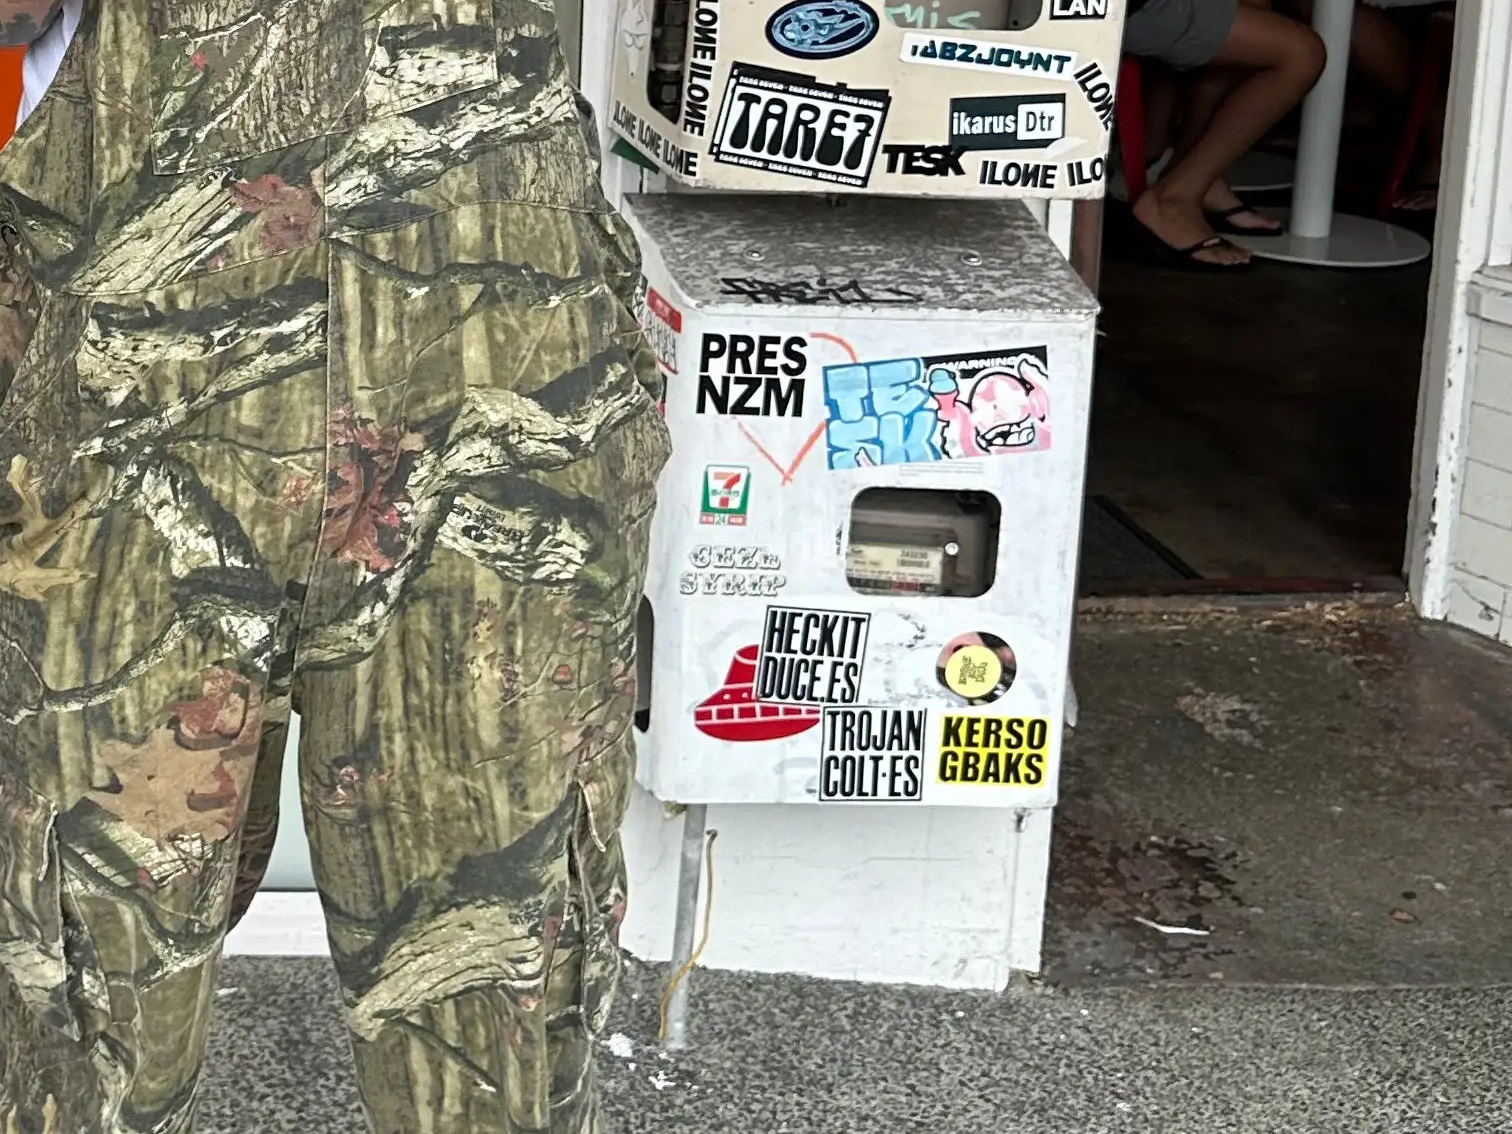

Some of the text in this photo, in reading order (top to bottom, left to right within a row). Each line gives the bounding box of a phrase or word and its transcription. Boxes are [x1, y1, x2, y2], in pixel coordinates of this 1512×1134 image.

[952, 111, 1055, 135] ikarus Dtr
[700, 333, 808, 376] PRES
[696, 375, 805, 417] NZM
[764, 610, 867, 659] HECKIT
[826, 710, 923, 751] TROJAN
[942, 716, 1048, 750] KERSO
[938, 750, 1044, 785] GBAKS
